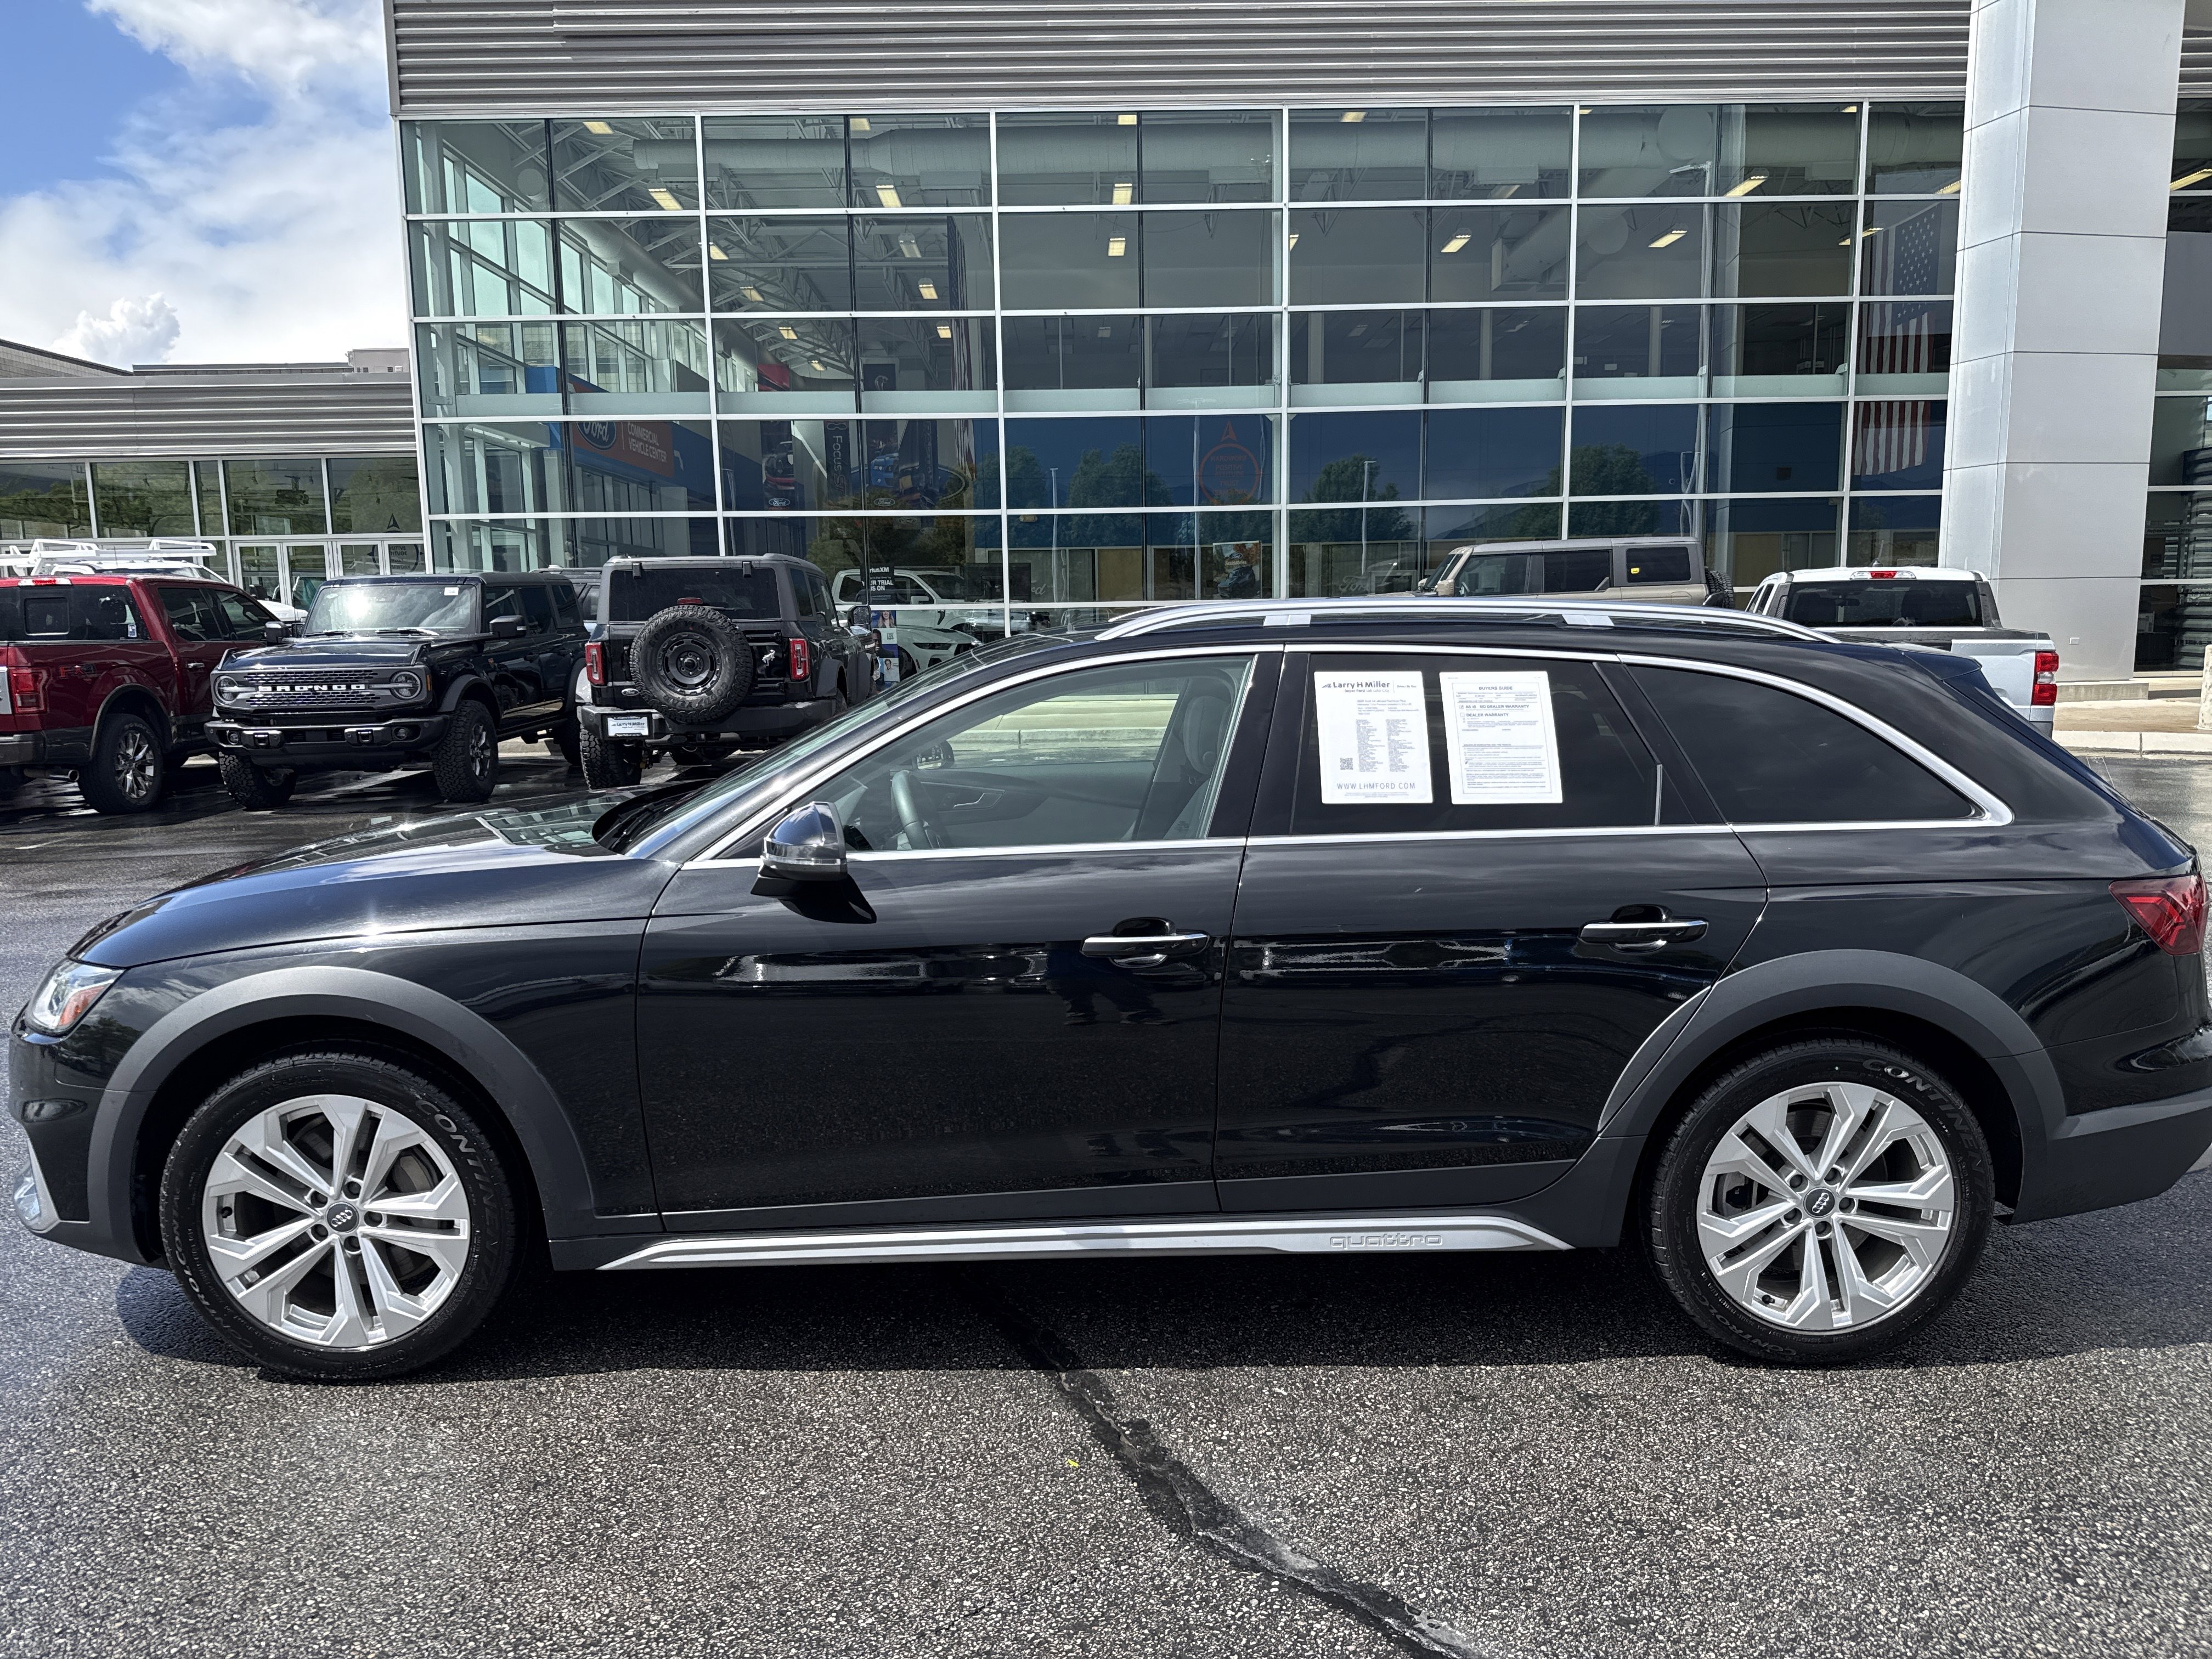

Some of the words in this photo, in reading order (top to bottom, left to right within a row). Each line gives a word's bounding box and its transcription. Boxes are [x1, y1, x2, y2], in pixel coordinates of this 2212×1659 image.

[628, 422, 659, 446] COMMERCIAL
[628, 437, 650, 456] VEHICLE
[649, 445, 667, 463] CENTER
[772, 498, 787, 506] Ford
[877, 498, 893, 506] Ford
[59, 663, 95, 678] FX4
[1329, 1233, 1443, 1250] quattro
